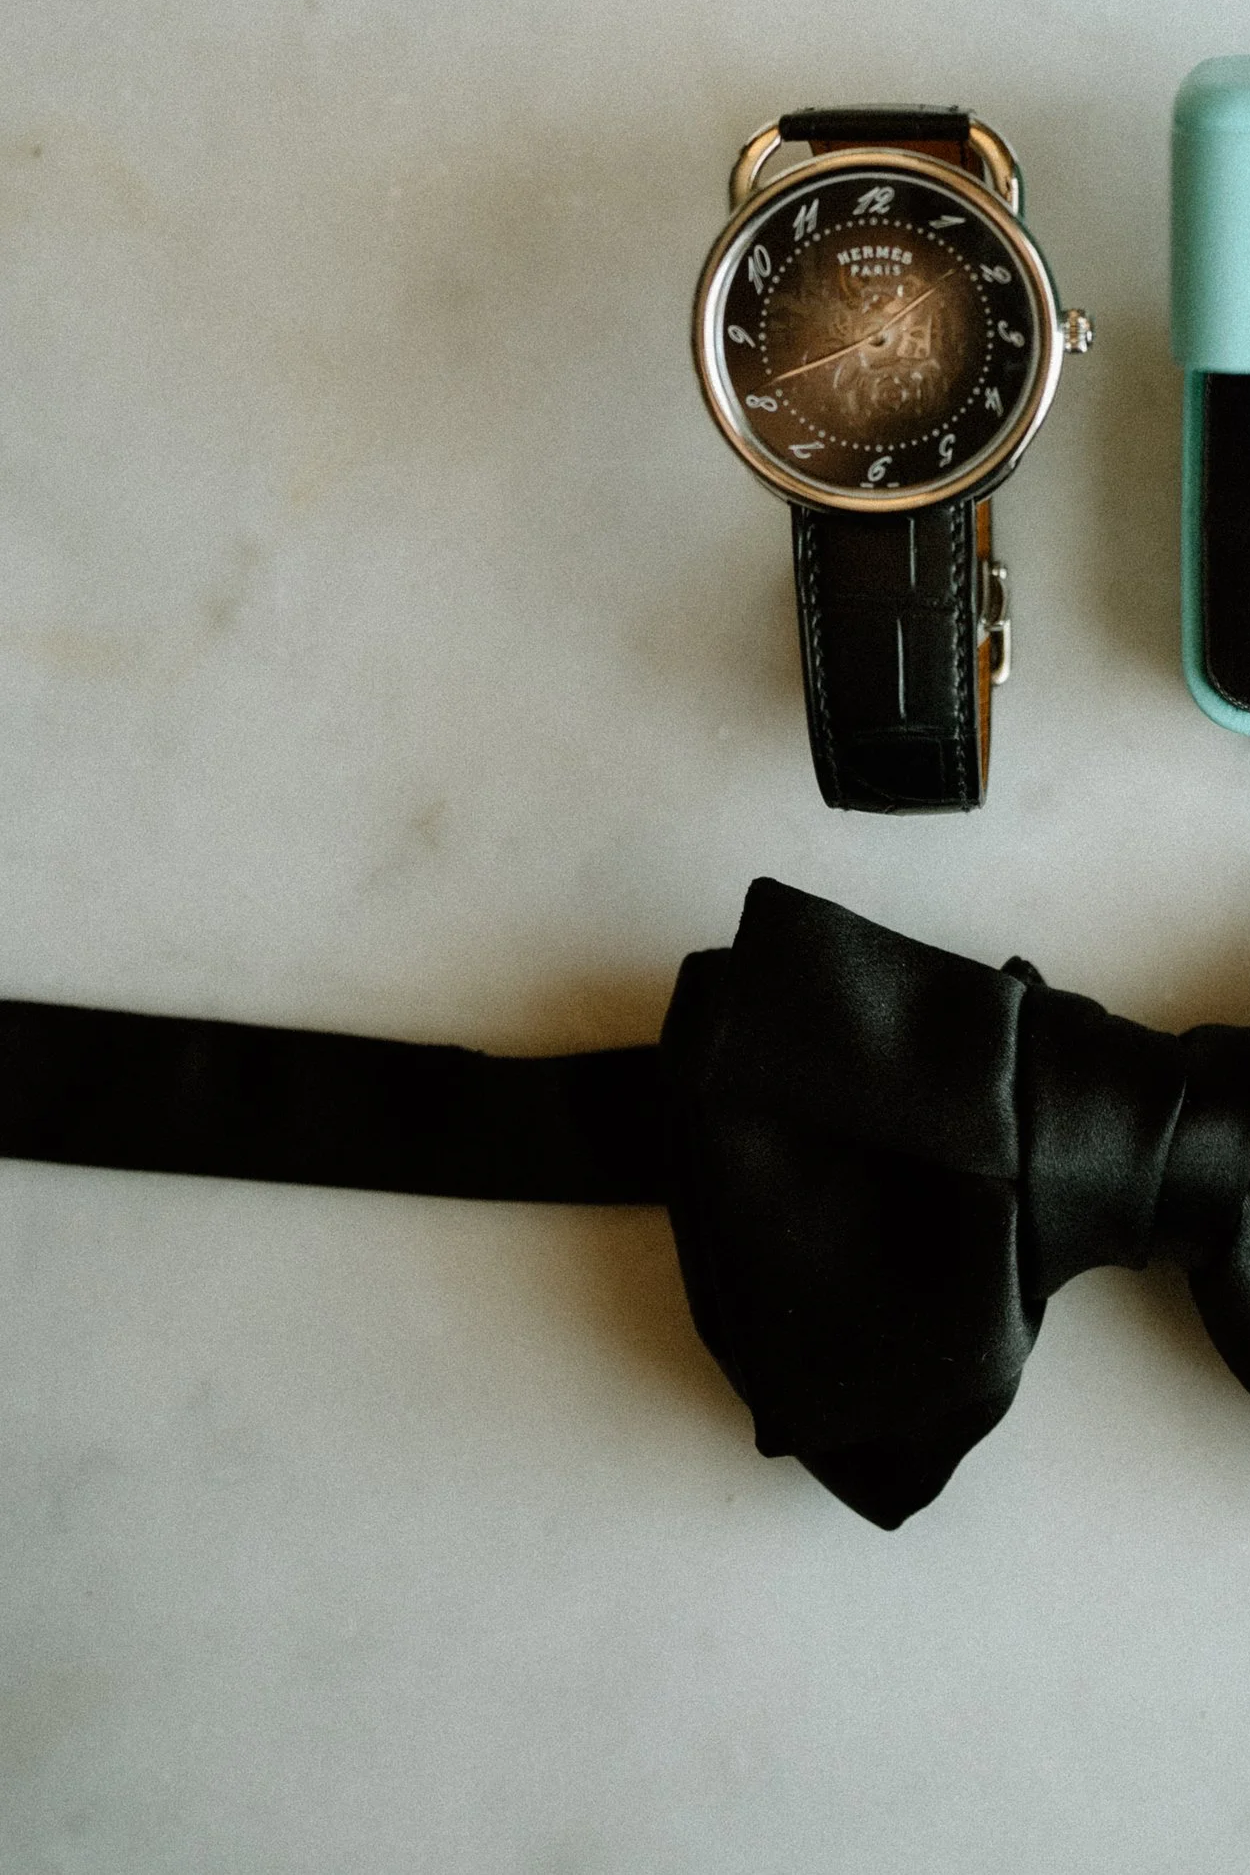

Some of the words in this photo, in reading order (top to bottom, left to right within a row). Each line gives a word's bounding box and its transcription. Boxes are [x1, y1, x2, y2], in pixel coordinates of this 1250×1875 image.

[853, 186, 895, 215] 12
[793, 198, 820, 242] 11
[748, 244, 771, 295] 10
[850, 264, 902, 278] PARIS
